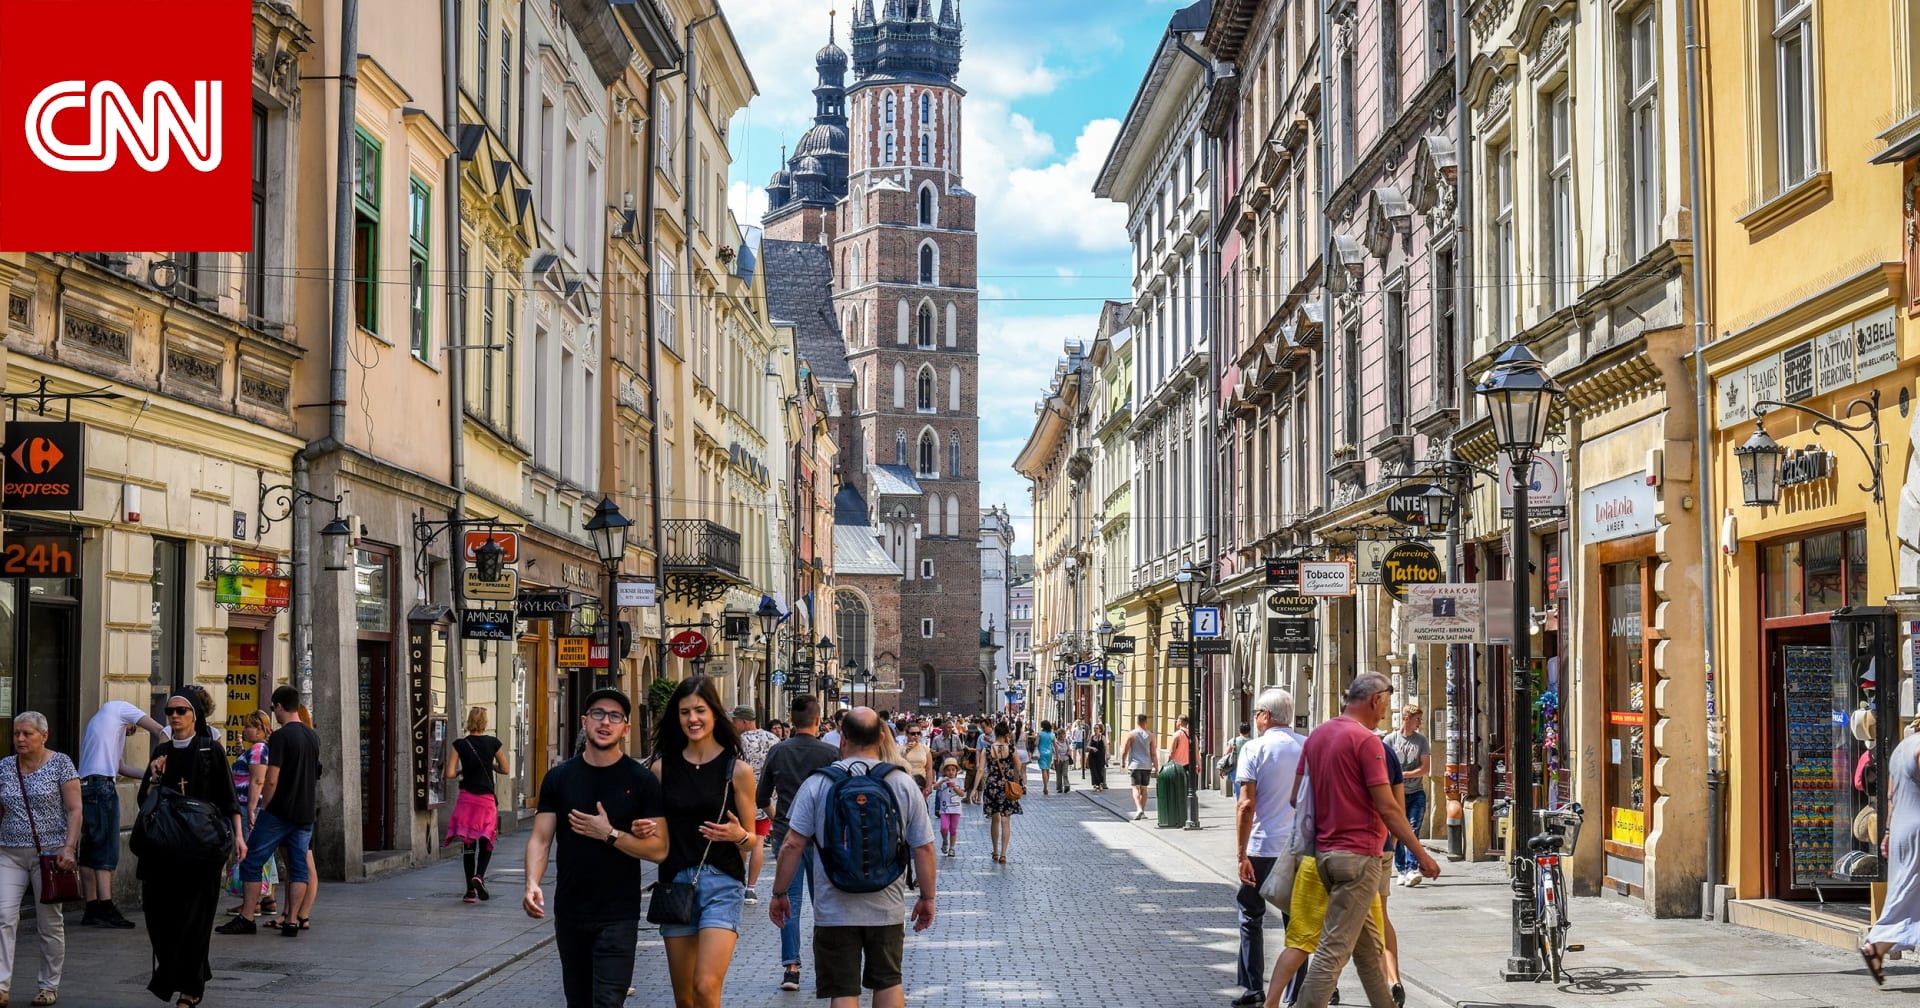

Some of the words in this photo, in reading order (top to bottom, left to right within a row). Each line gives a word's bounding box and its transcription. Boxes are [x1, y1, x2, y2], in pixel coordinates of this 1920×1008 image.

[1818, 338, 1852, 369] TATTOO
[1784, 354, 1812, 378] HIP-HOP
[1751, 367, 1778, 393] FLAMES
[1785, 369, 1812, 395] STUFF
[1820, 363, 1851, 388] PIERCING
[5, 482, 70, 498] express
[1596, 496, 1633, 523] LolaLola
[1607, 520, 1624, 531] AMBER
[5, 543, 72, 573] 24h
[1393, 550, 1429, 558] piercing
[1305, 570, 1345, 579] Tobacco
[1386, 561, 1438, 583] Tattoo
[1306, 580, 1344, 590] Cigarettes
[1271, 597, 1314, 605] KANTOR
[466, 612, 509, 623] AMNESIA
[489, 629, 504, 638] club
[1112, 640, 1134, 650] mpik
